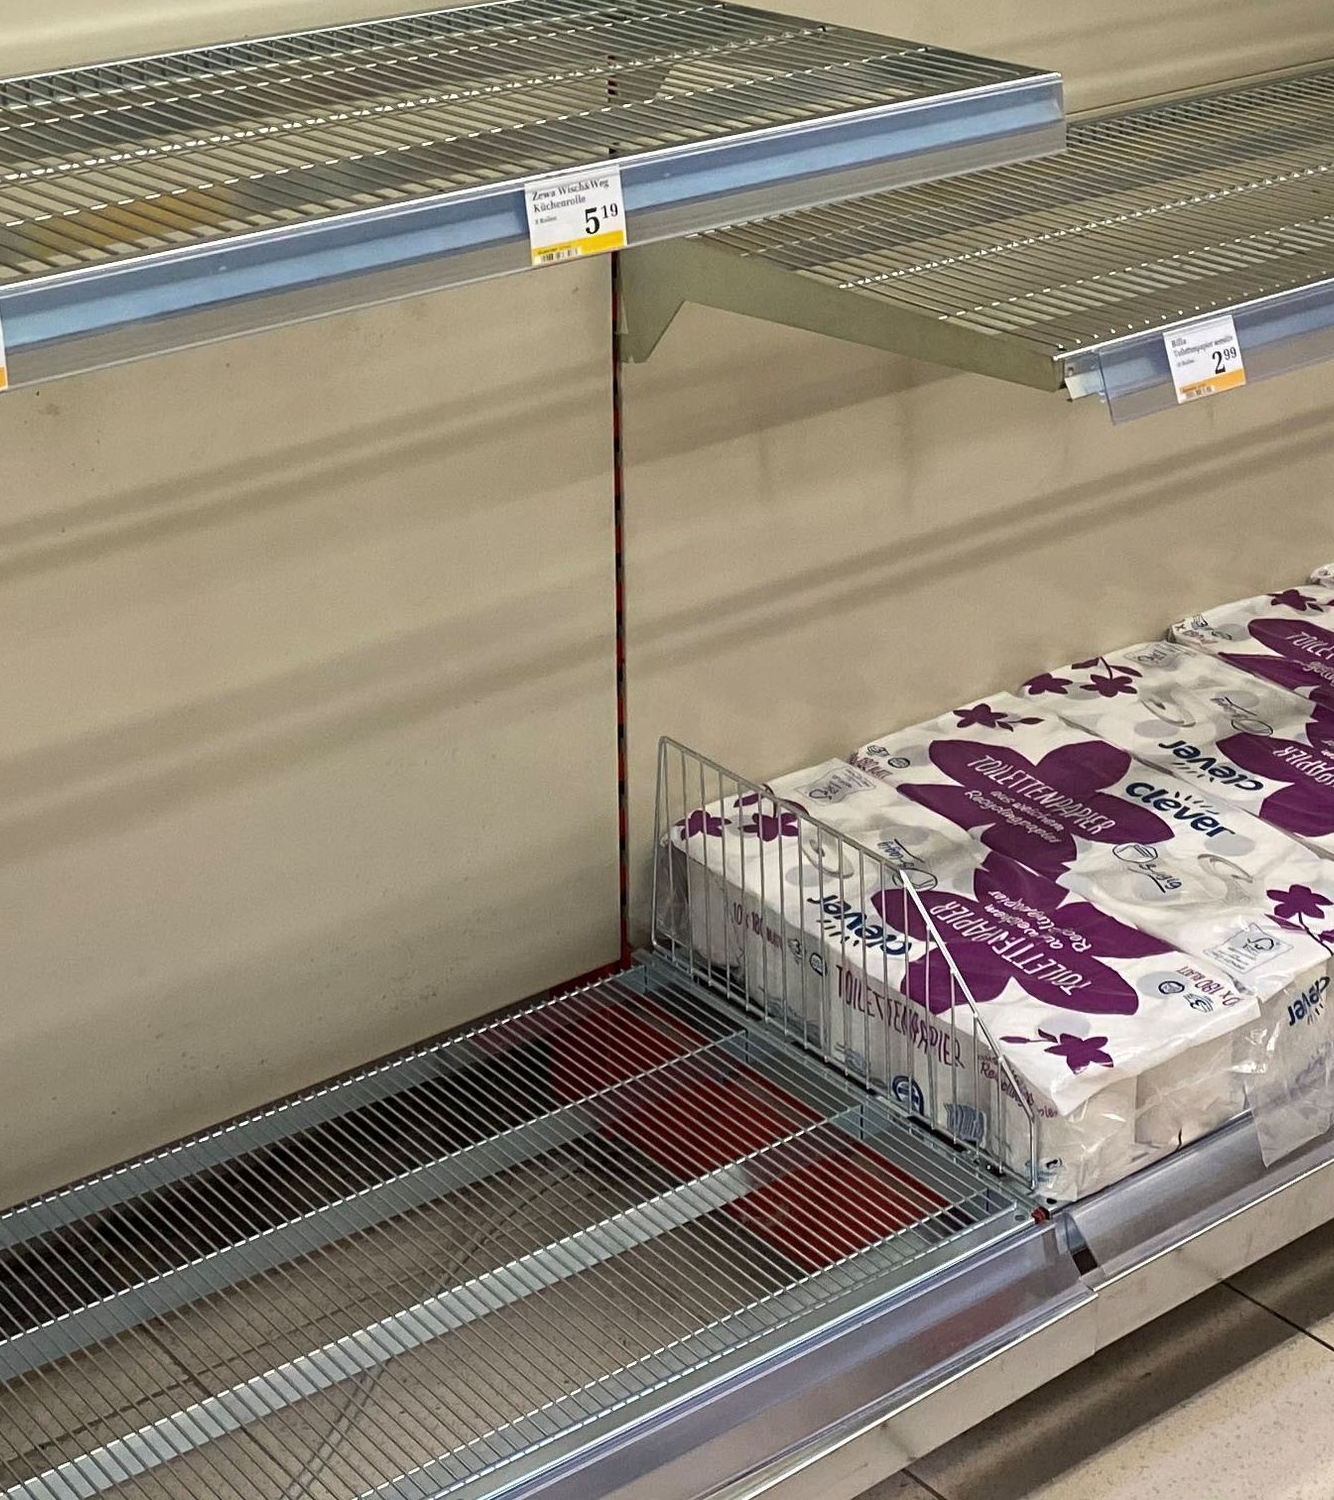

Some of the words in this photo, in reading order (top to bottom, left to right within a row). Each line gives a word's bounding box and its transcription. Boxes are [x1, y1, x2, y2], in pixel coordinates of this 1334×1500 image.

[532, 190, 556, 201] Zewa
[557, 179, 610, 196] Wisch&Weg
[533, 194, 587, 213] Küchenrolle
[1157, 739, 1265, 792] clever
[967, 754, 1116, 836] TOILETTENPAPIER
[1125, 781, 1236, 838] clever
[808, 893, 913, 958] clever
[930, 900, 1092, 997] TOILETTENPAPIER
